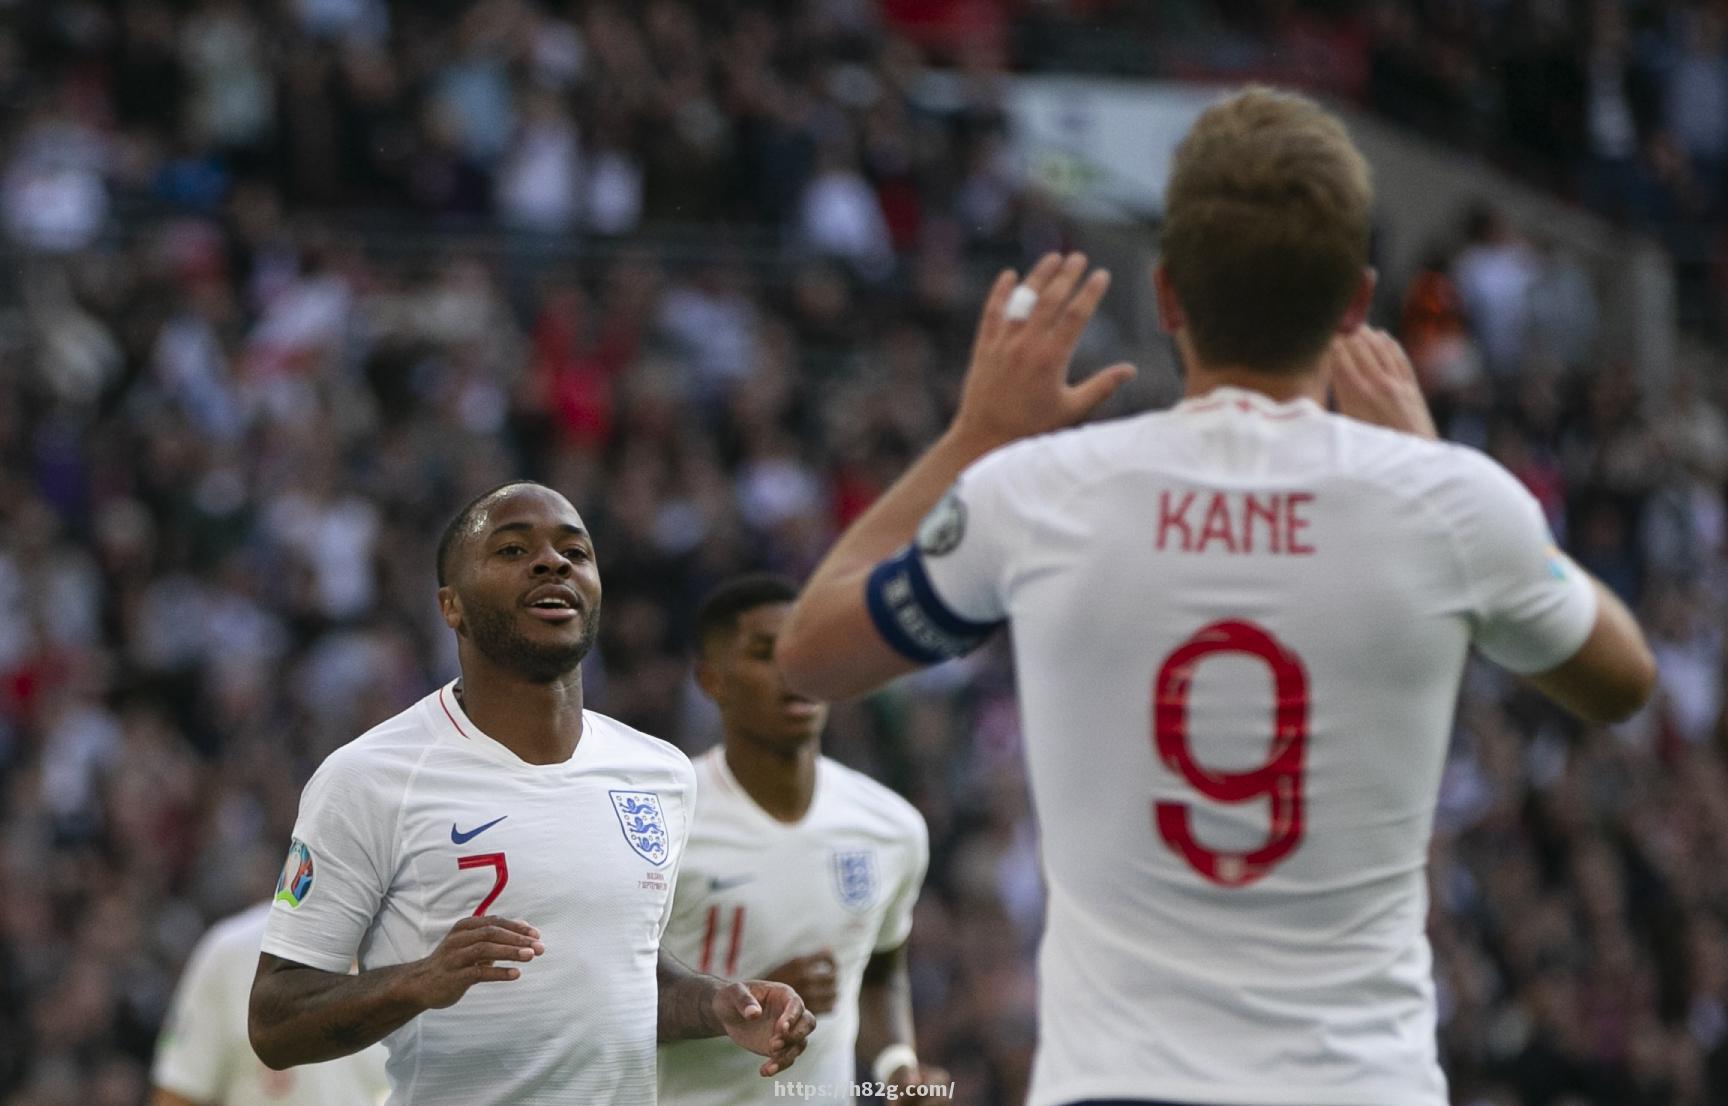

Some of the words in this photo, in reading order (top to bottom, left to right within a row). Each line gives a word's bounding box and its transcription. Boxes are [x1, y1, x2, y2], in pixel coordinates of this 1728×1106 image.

[1155, 490, 1316, 554] KANE
[1153, 616, 1311, 888] 9
[457, 852, 509, 918] 7
[698, 904, 746, 975] 11
